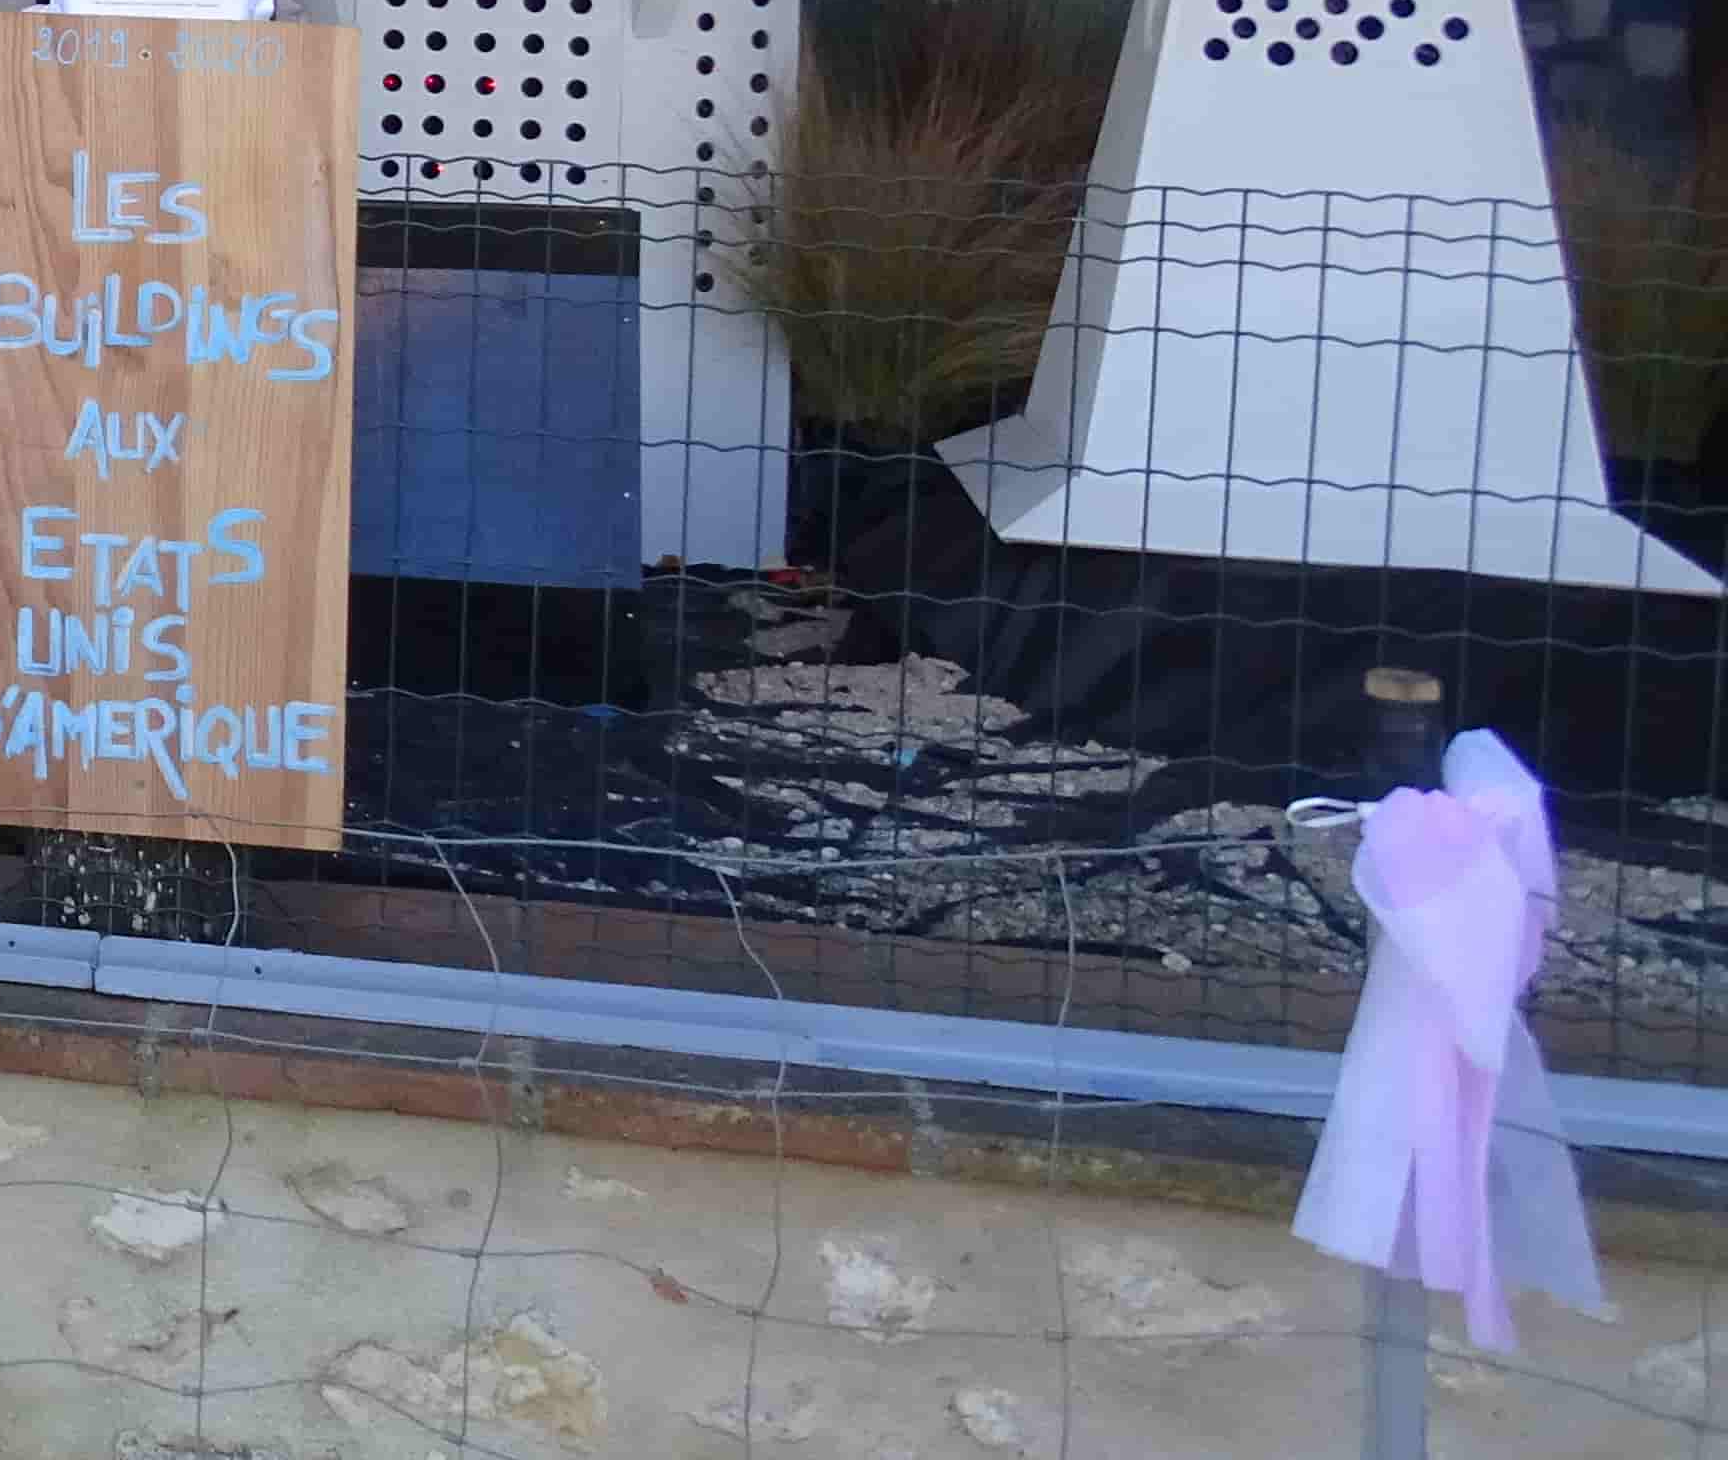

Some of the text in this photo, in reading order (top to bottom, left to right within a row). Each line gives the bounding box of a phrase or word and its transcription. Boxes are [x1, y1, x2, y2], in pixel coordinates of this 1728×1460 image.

[71, 148, 208, 244] LES
[64, 397, 187, 481] AUX
[19, 503, 267, 614] ETATS
